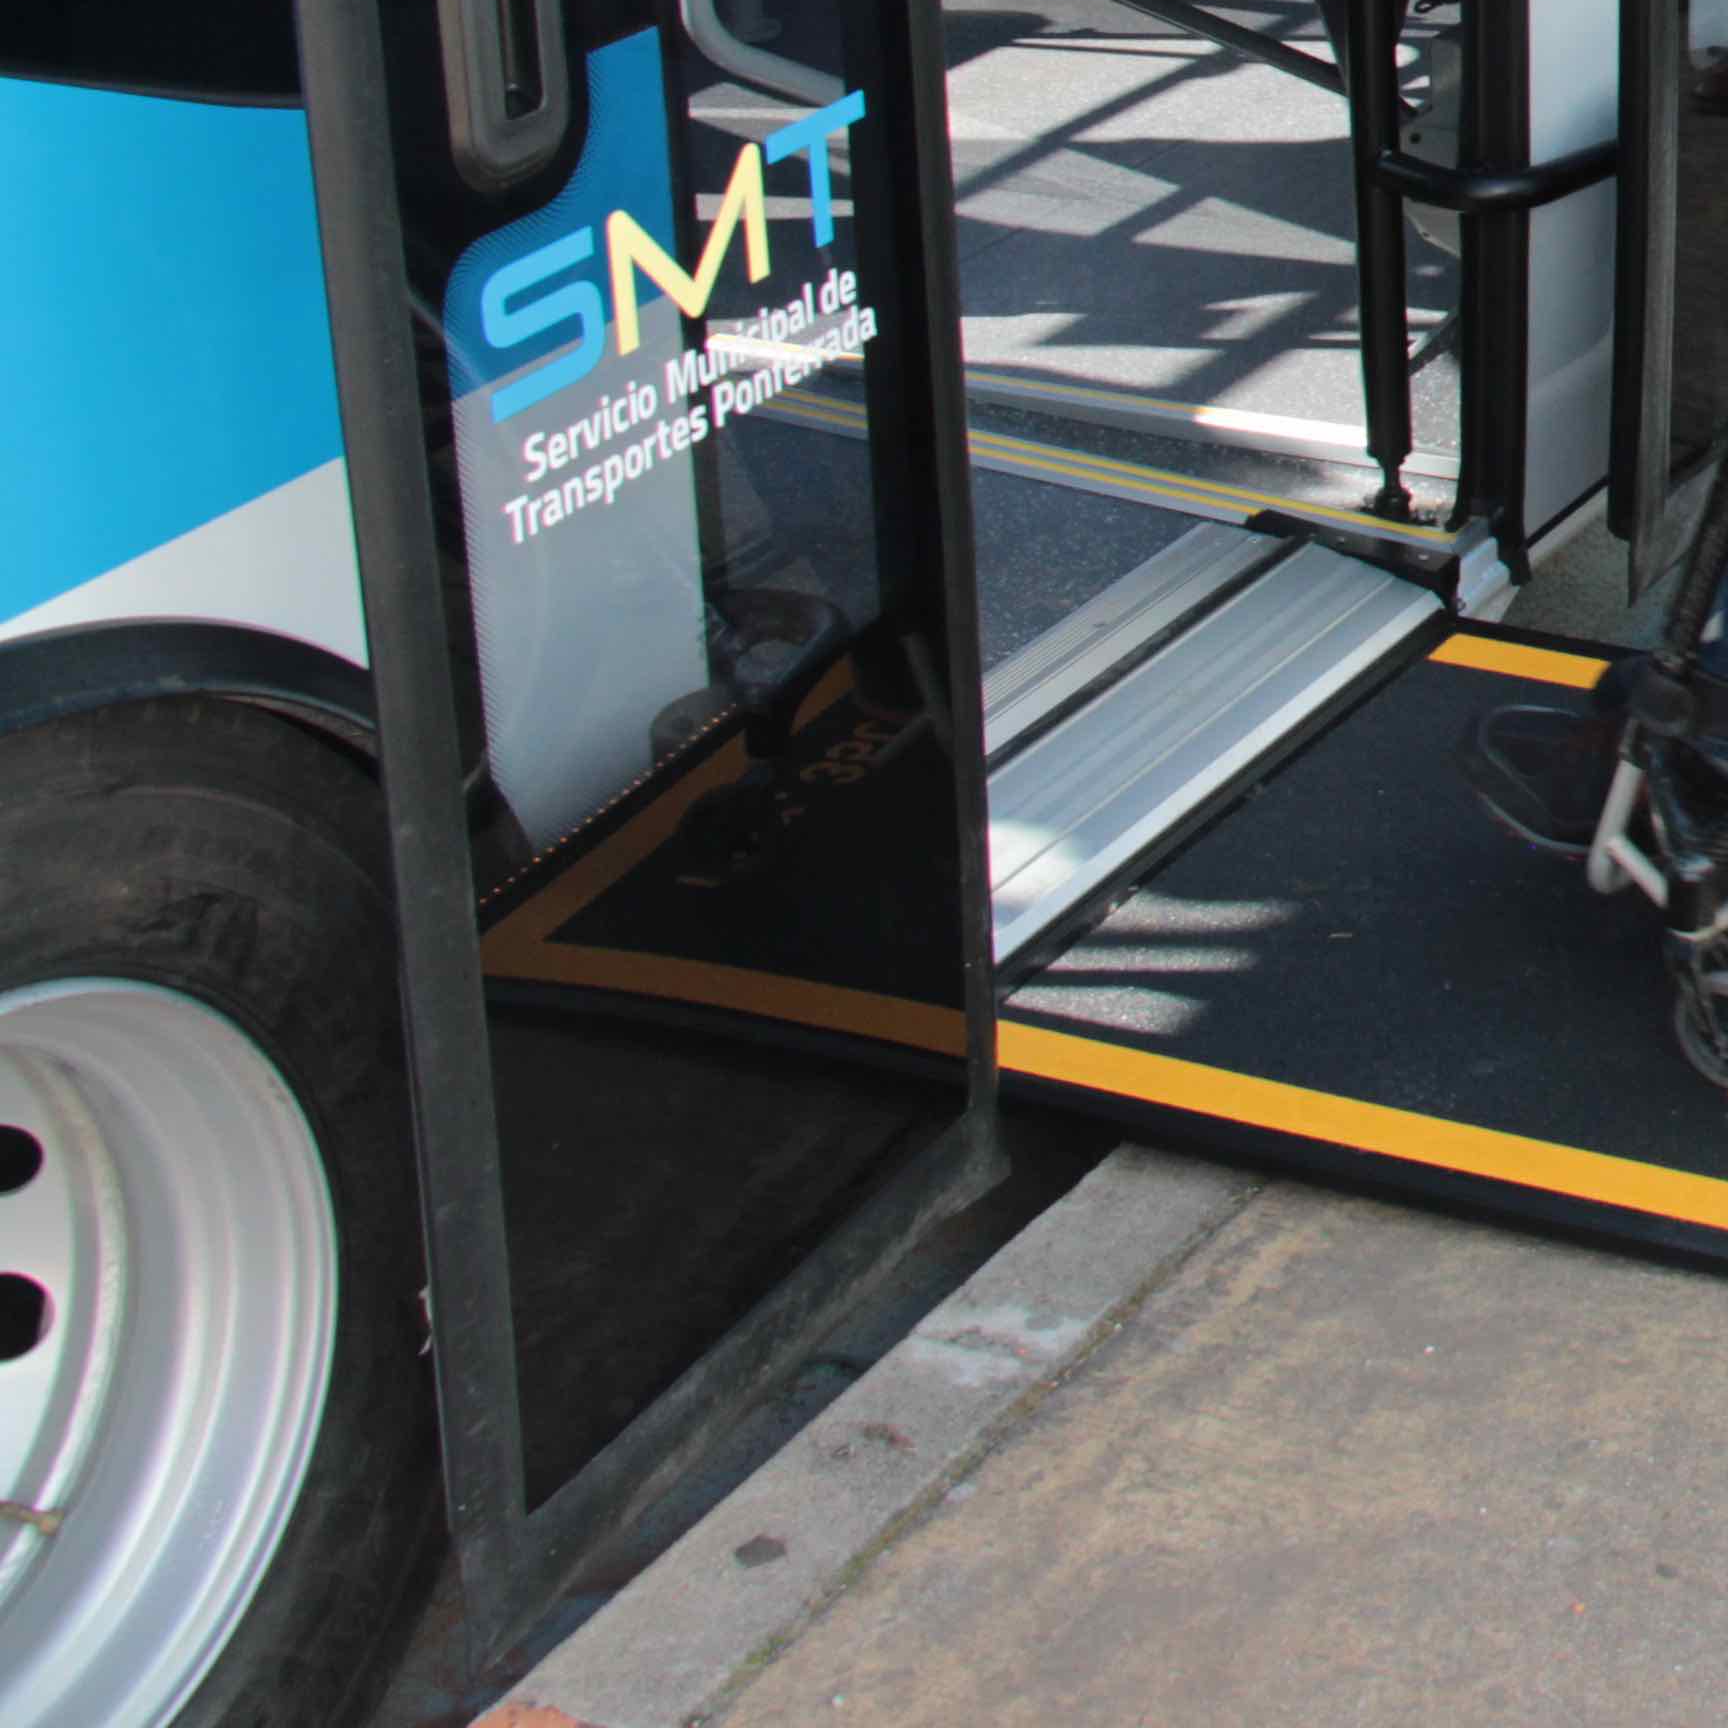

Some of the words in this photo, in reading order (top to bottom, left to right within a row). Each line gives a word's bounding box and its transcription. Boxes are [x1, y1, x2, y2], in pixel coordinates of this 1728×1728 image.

[481, 89, 866, 425] SMT
[502, 404, 710, 545] Transportes
[521, 380, 658, 483] Servicio
[818, 267, 858, 315] de
